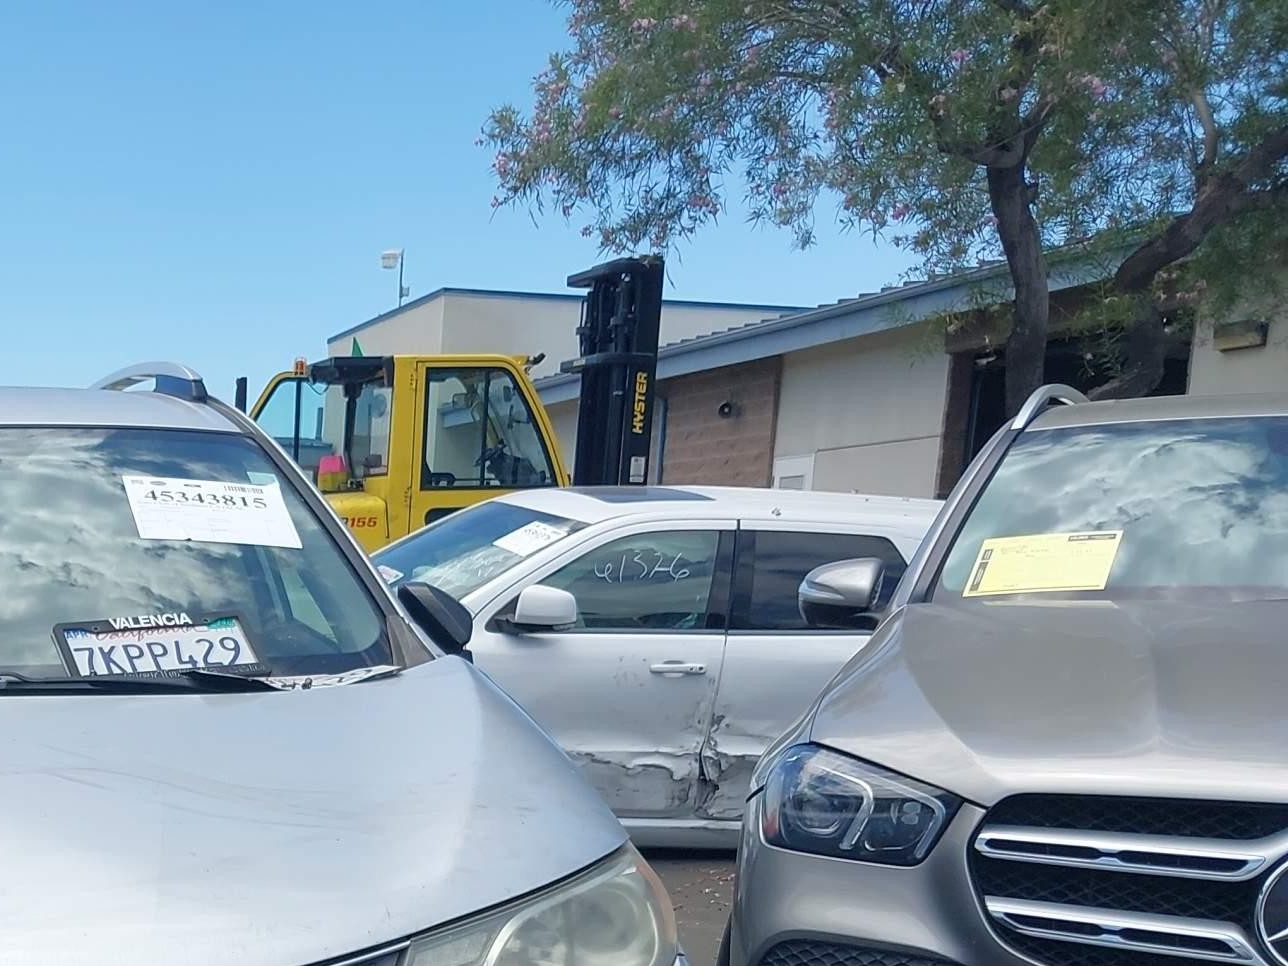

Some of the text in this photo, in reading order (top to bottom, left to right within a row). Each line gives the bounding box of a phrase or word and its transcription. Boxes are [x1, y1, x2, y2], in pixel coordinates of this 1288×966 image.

[632, 371, 648, 434] HYSTER
[144, 489, 268, 509] 45343815
[108, 612, 193, 630] VALENCIA
[73, 636, 241, 676] 7KPP429
